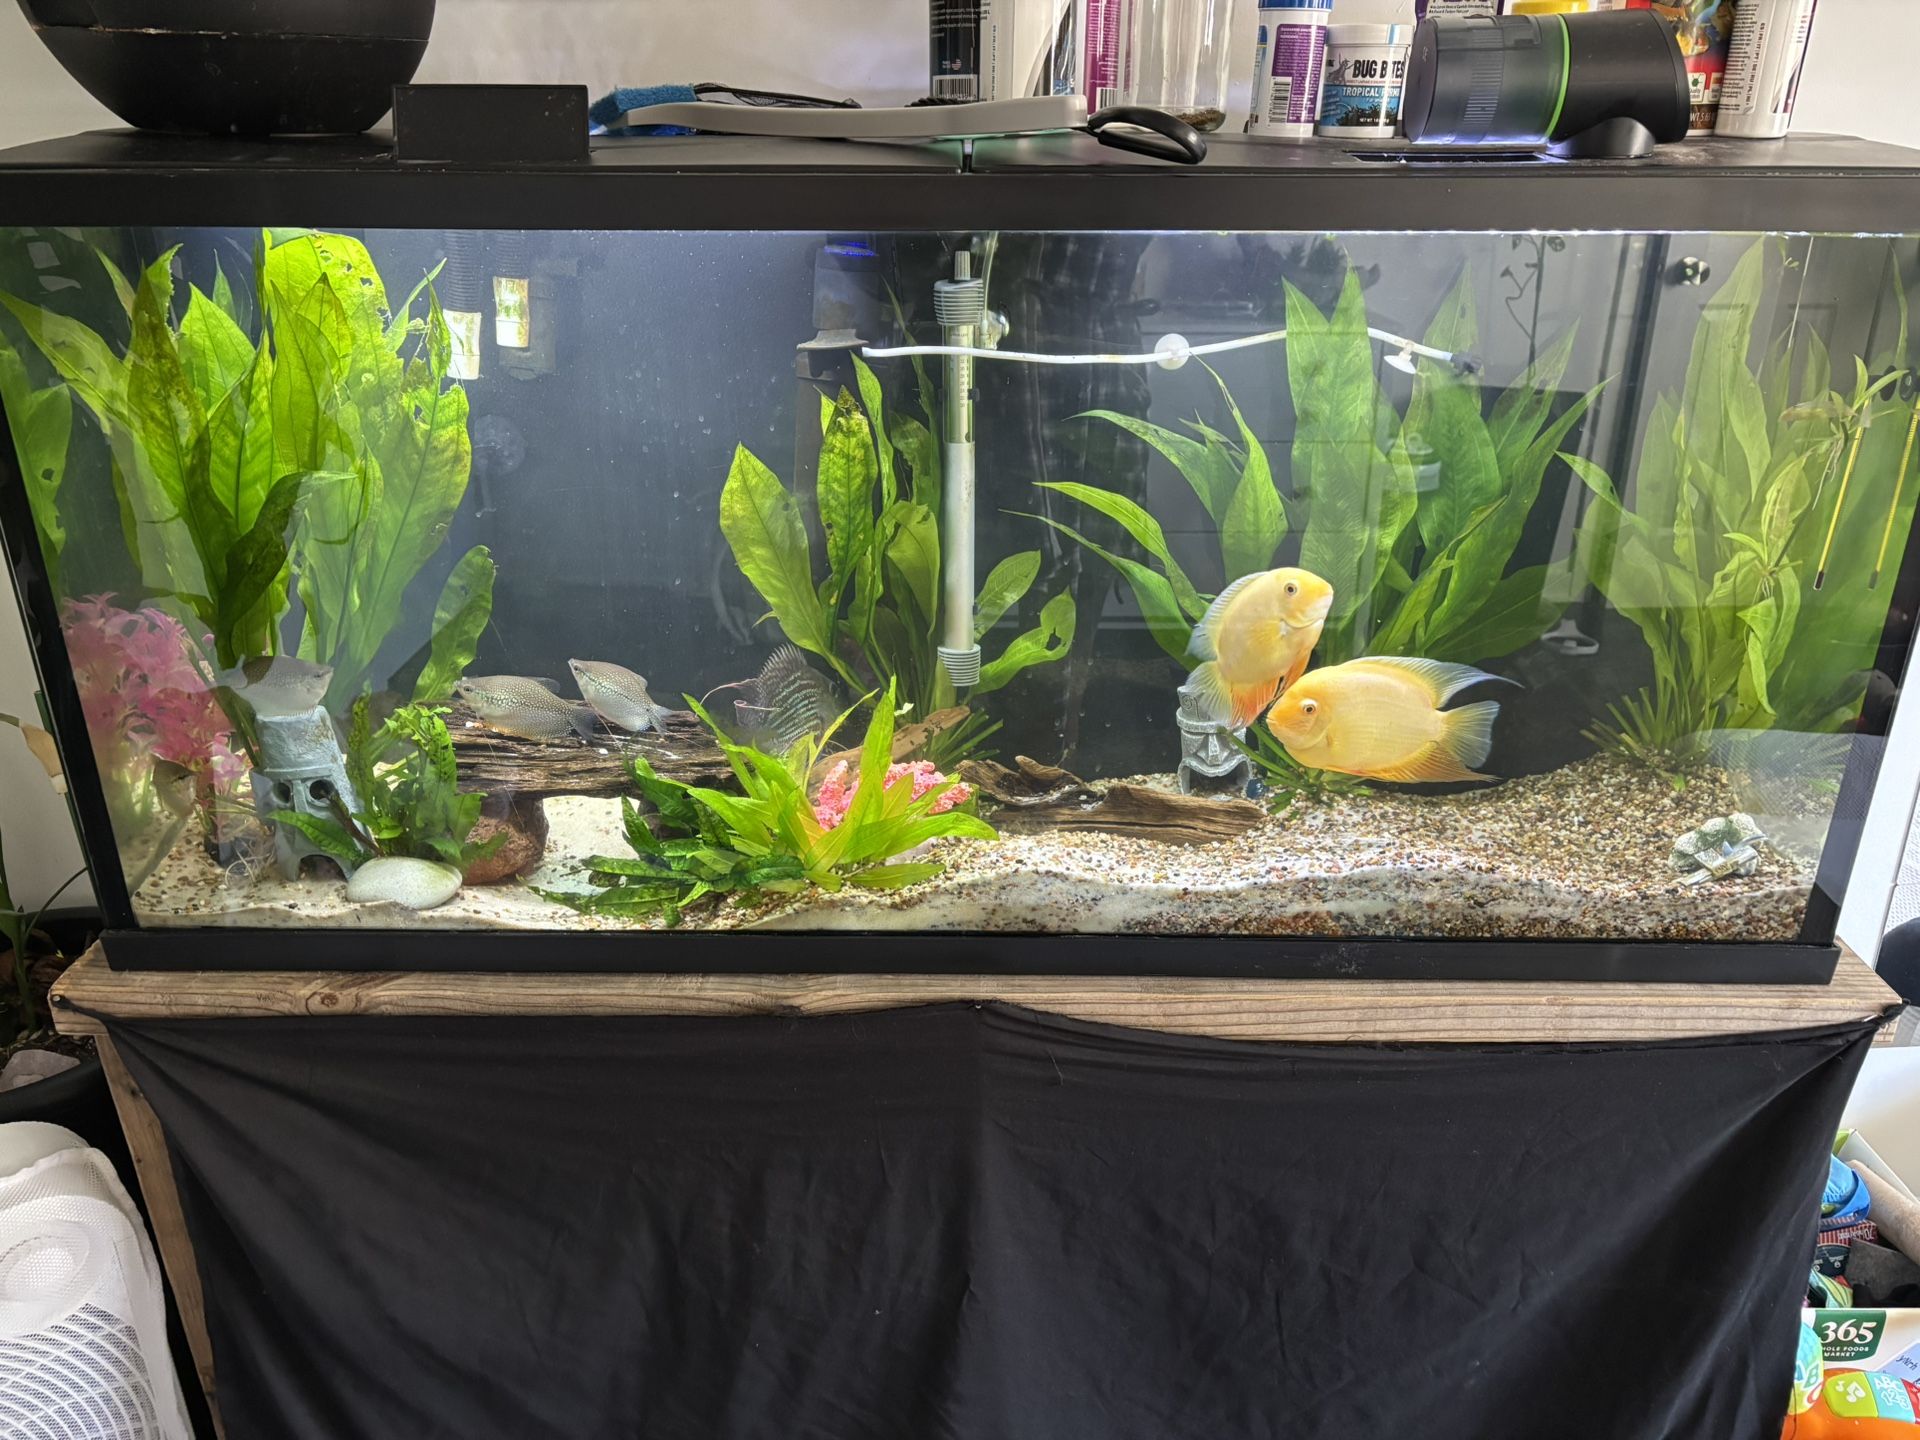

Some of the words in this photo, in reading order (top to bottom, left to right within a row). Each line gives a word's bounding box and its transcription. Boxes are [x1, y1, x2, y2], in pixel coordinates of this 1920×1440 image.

[1352, 60, 1377, 78] BUG
[1379, 60, 1405, 79] BTES
[1342, 87, 1380, 96] TROPICAL
[1820, 1319, 1877, 1344] 365
